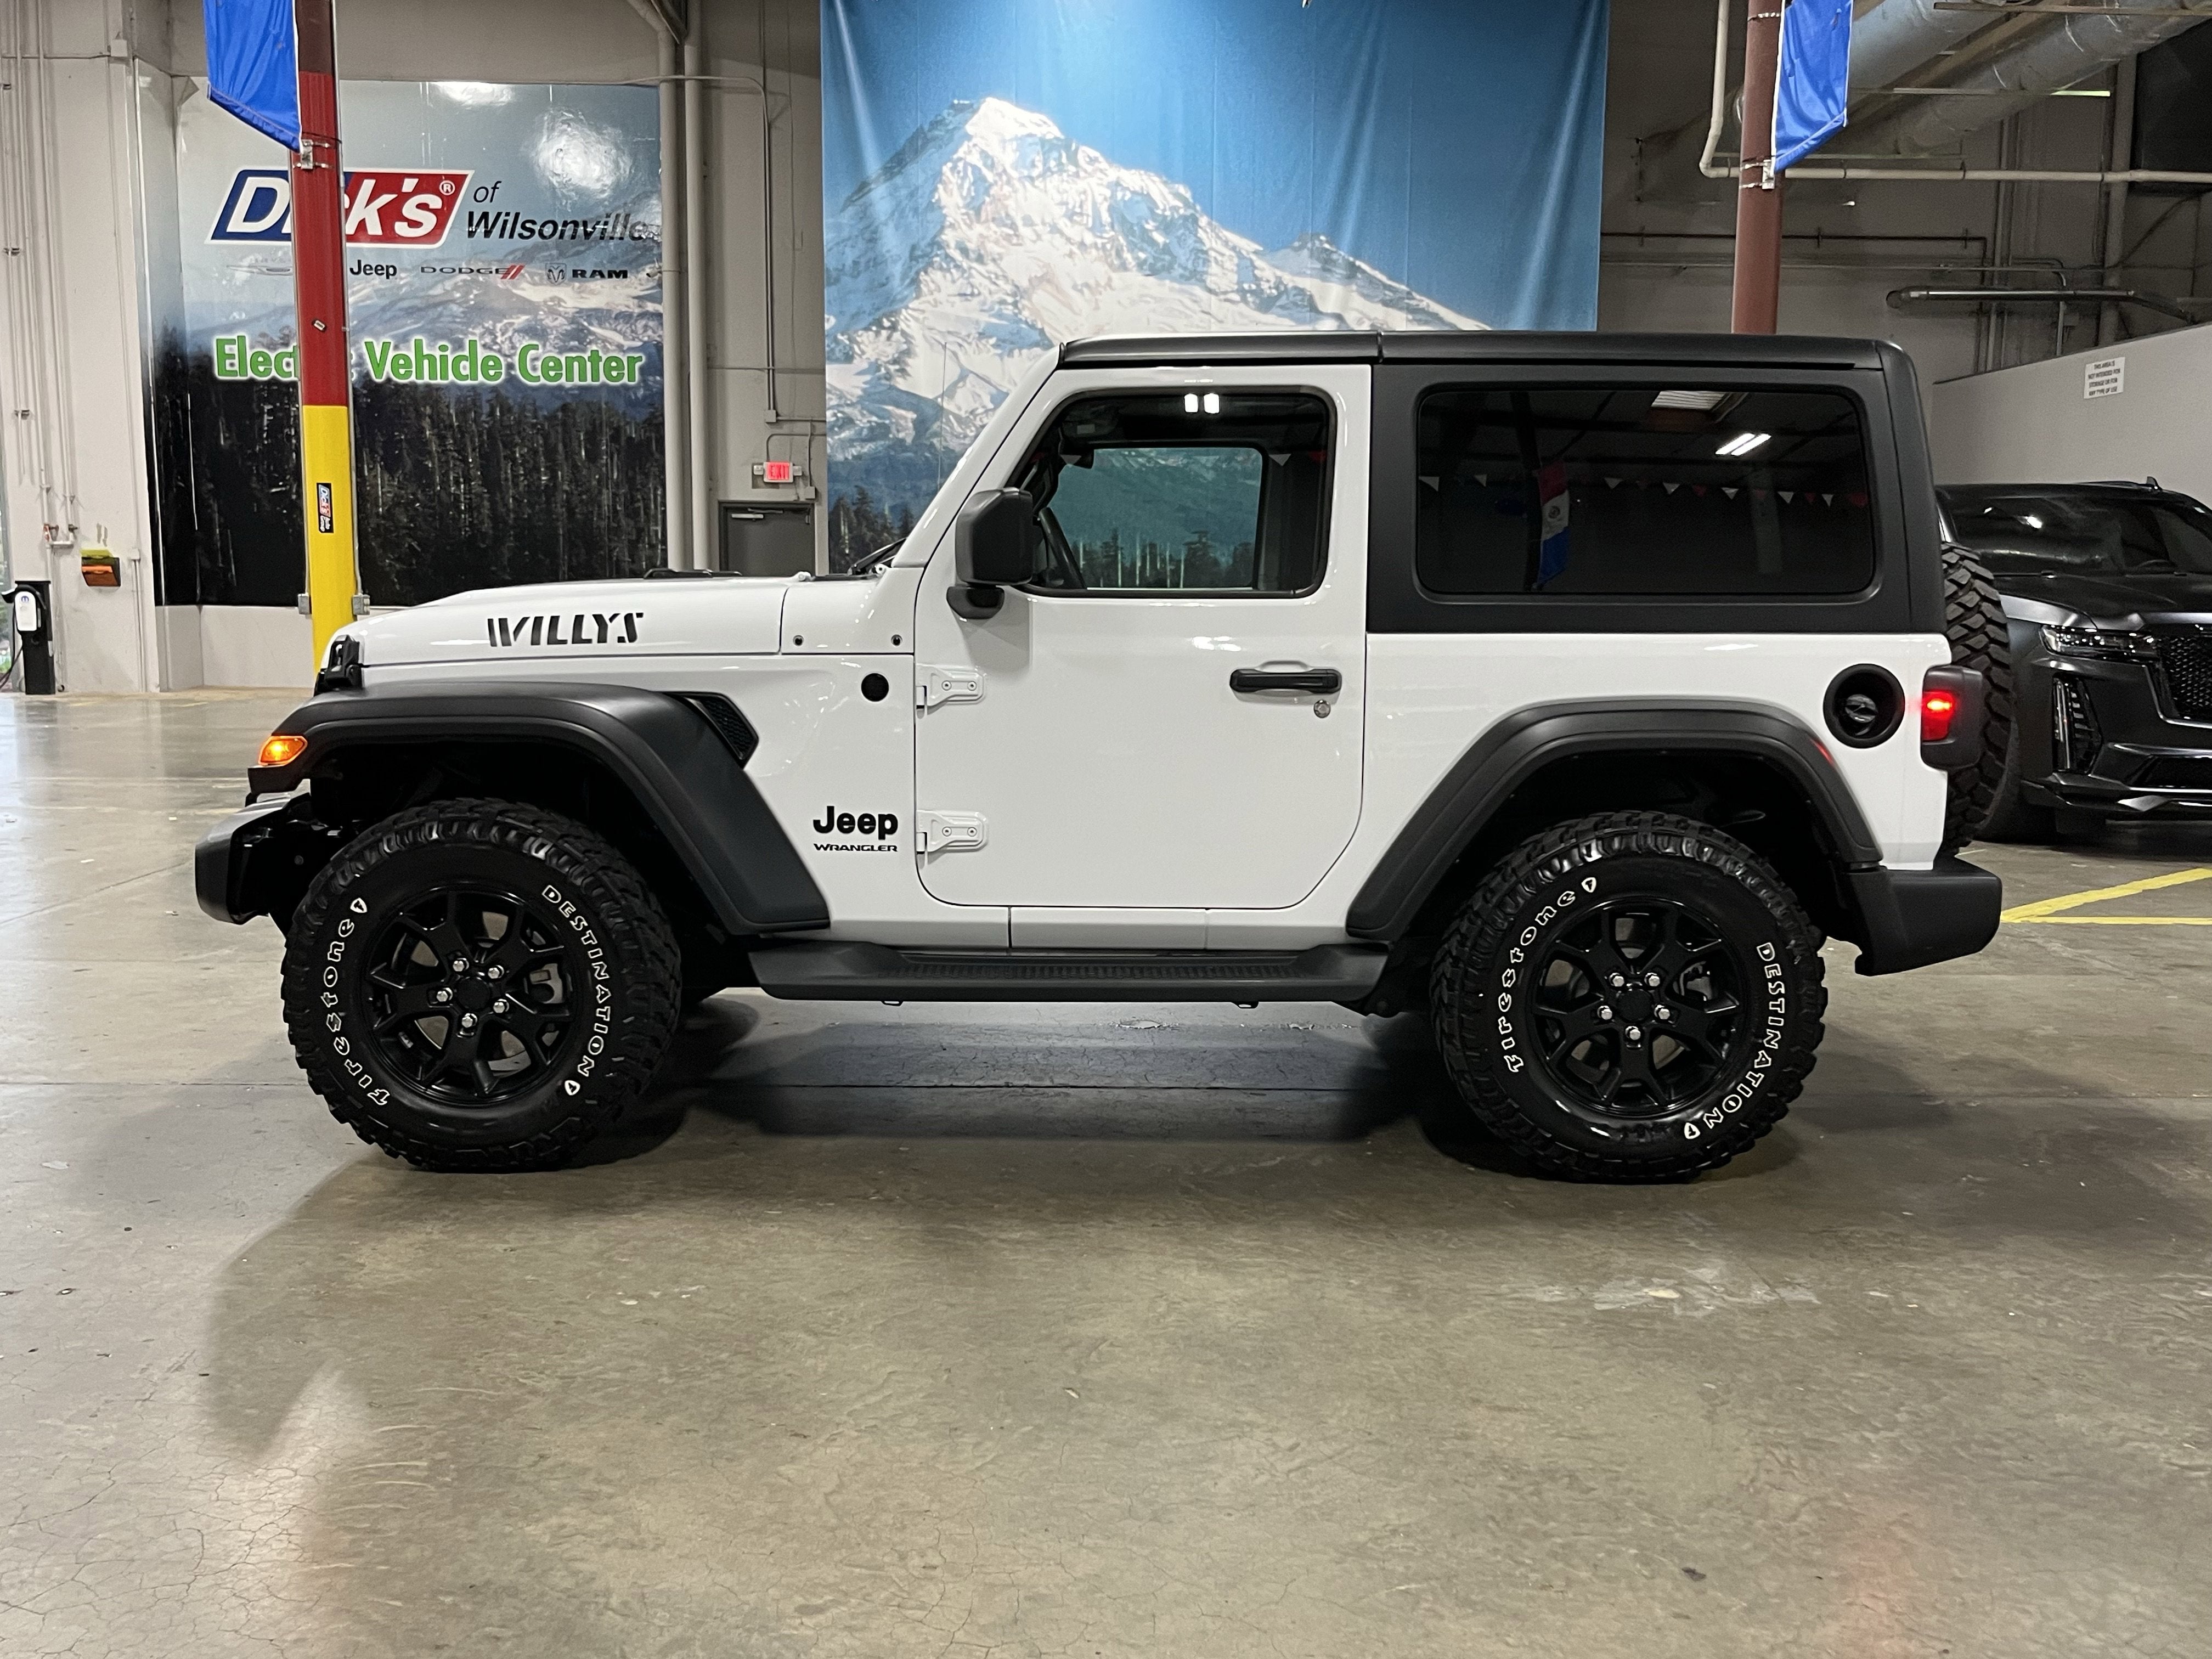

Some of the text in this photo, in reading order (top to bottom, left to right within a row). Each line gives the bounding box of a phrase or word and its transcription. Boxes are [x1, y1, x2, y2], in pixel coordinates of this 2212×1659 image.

[225, 176, 443, 238] Dk's
[473, 180, 502, 203] of
[467, 211, 648, 241] Wilsonville
[349, 259, 628, 279] Jeep DODGE RAM
[216, 335, 643, 383] Elect Vehicle Center
[769, 464, 789, 479] EXIT
[487, 612, 644, 647] WILLYS
[812, 805, 899, 840] Jeep
[813, 843, 898, 852] WRANGLER
[541, 884, 611, 1077] DESTINATION
[1498, 890, 1576, 1073] Firestone
[320, 918, 391, 1106] Firestone
[1702, 942, 1786, 1130] DESTINATION
